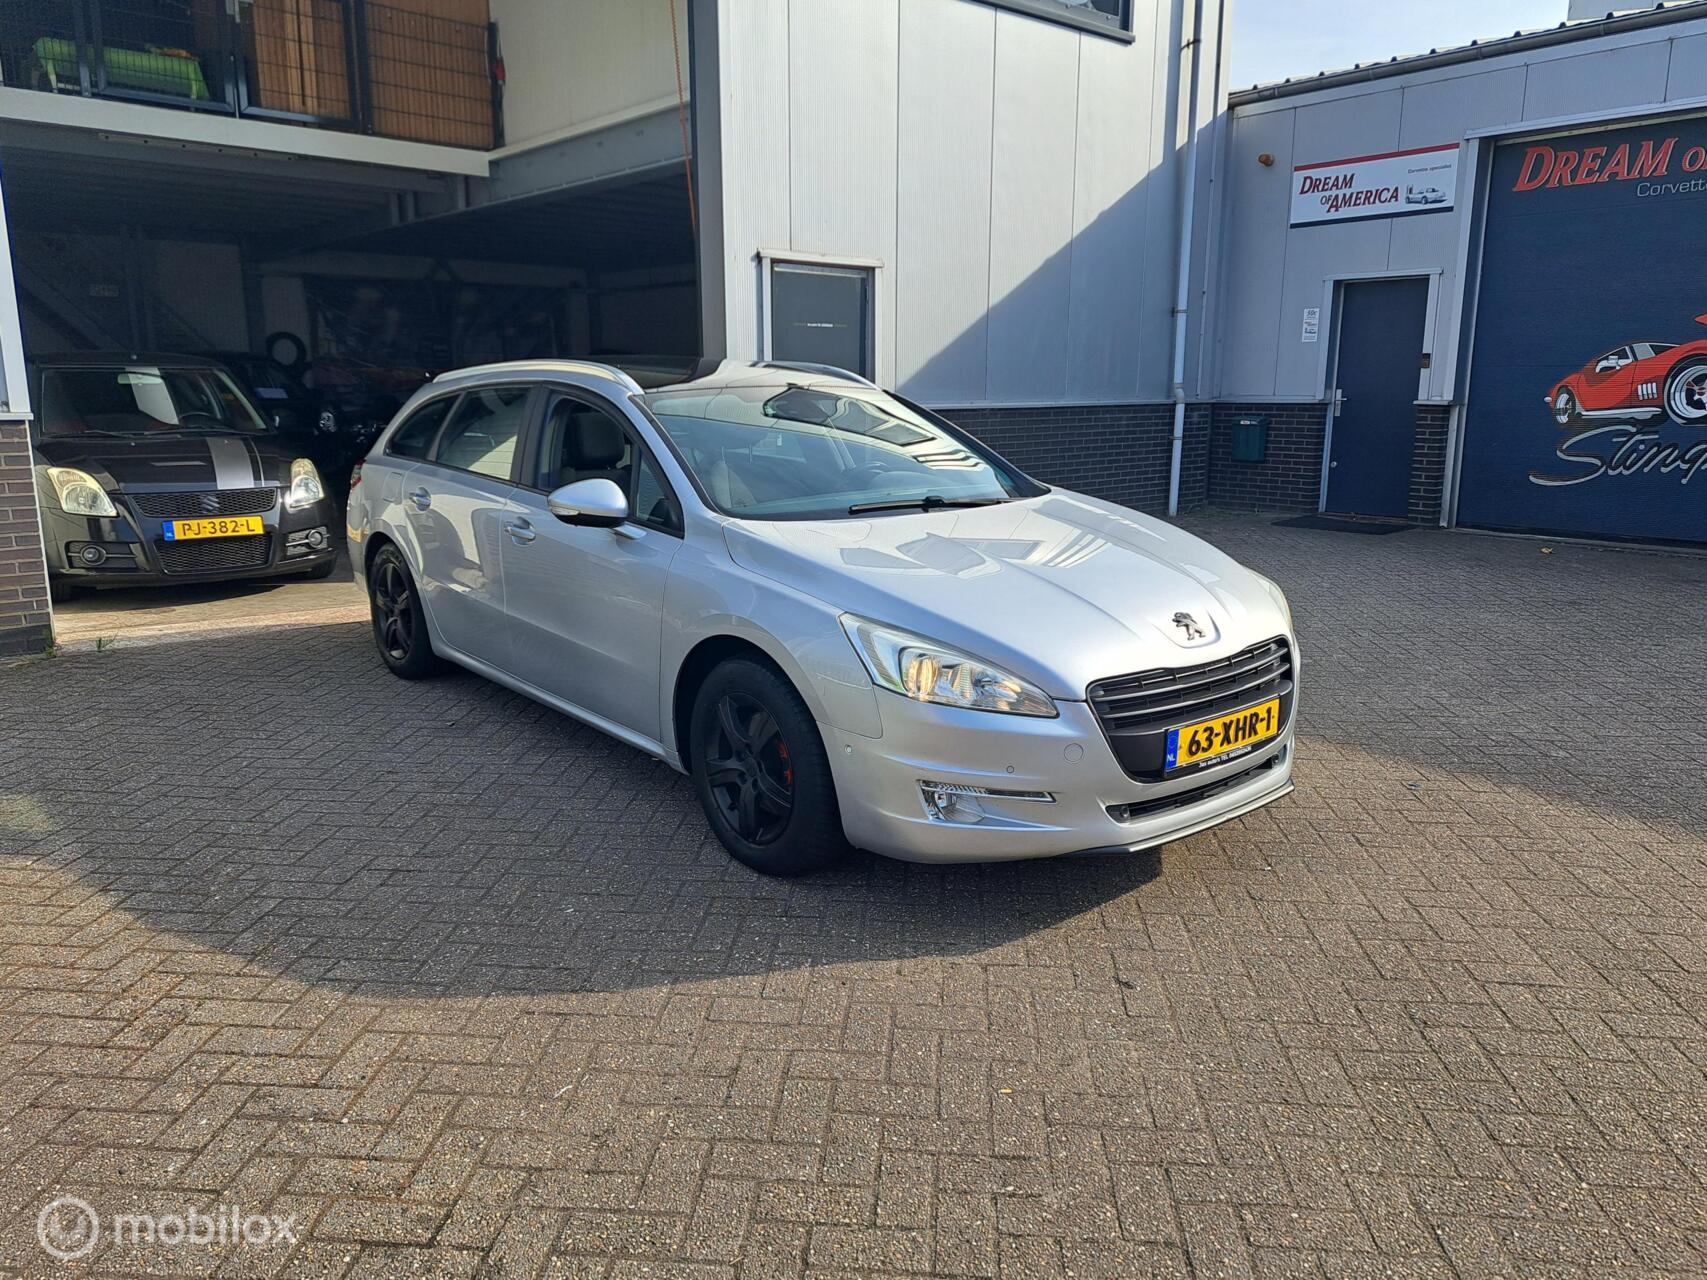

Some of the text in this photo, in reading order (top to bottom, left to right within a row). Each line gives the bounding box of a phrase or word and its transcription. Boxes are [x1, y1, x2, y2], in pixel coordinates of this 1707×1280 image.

[1512, 137, 1707, 192] DREAM O
[1299, 173, 1355, 195] DREAM
[1637, 178, 1707, 197] Corvett
[1326, 186, 1399, 213] AMERICA
[1529, 424, 1707, 486] Sting
[182, 519, 256, 537] PJ-382-L
[1167, 753, 1176, 762] NL
[1188, 706, 1272, 757] 63-XHR-1
